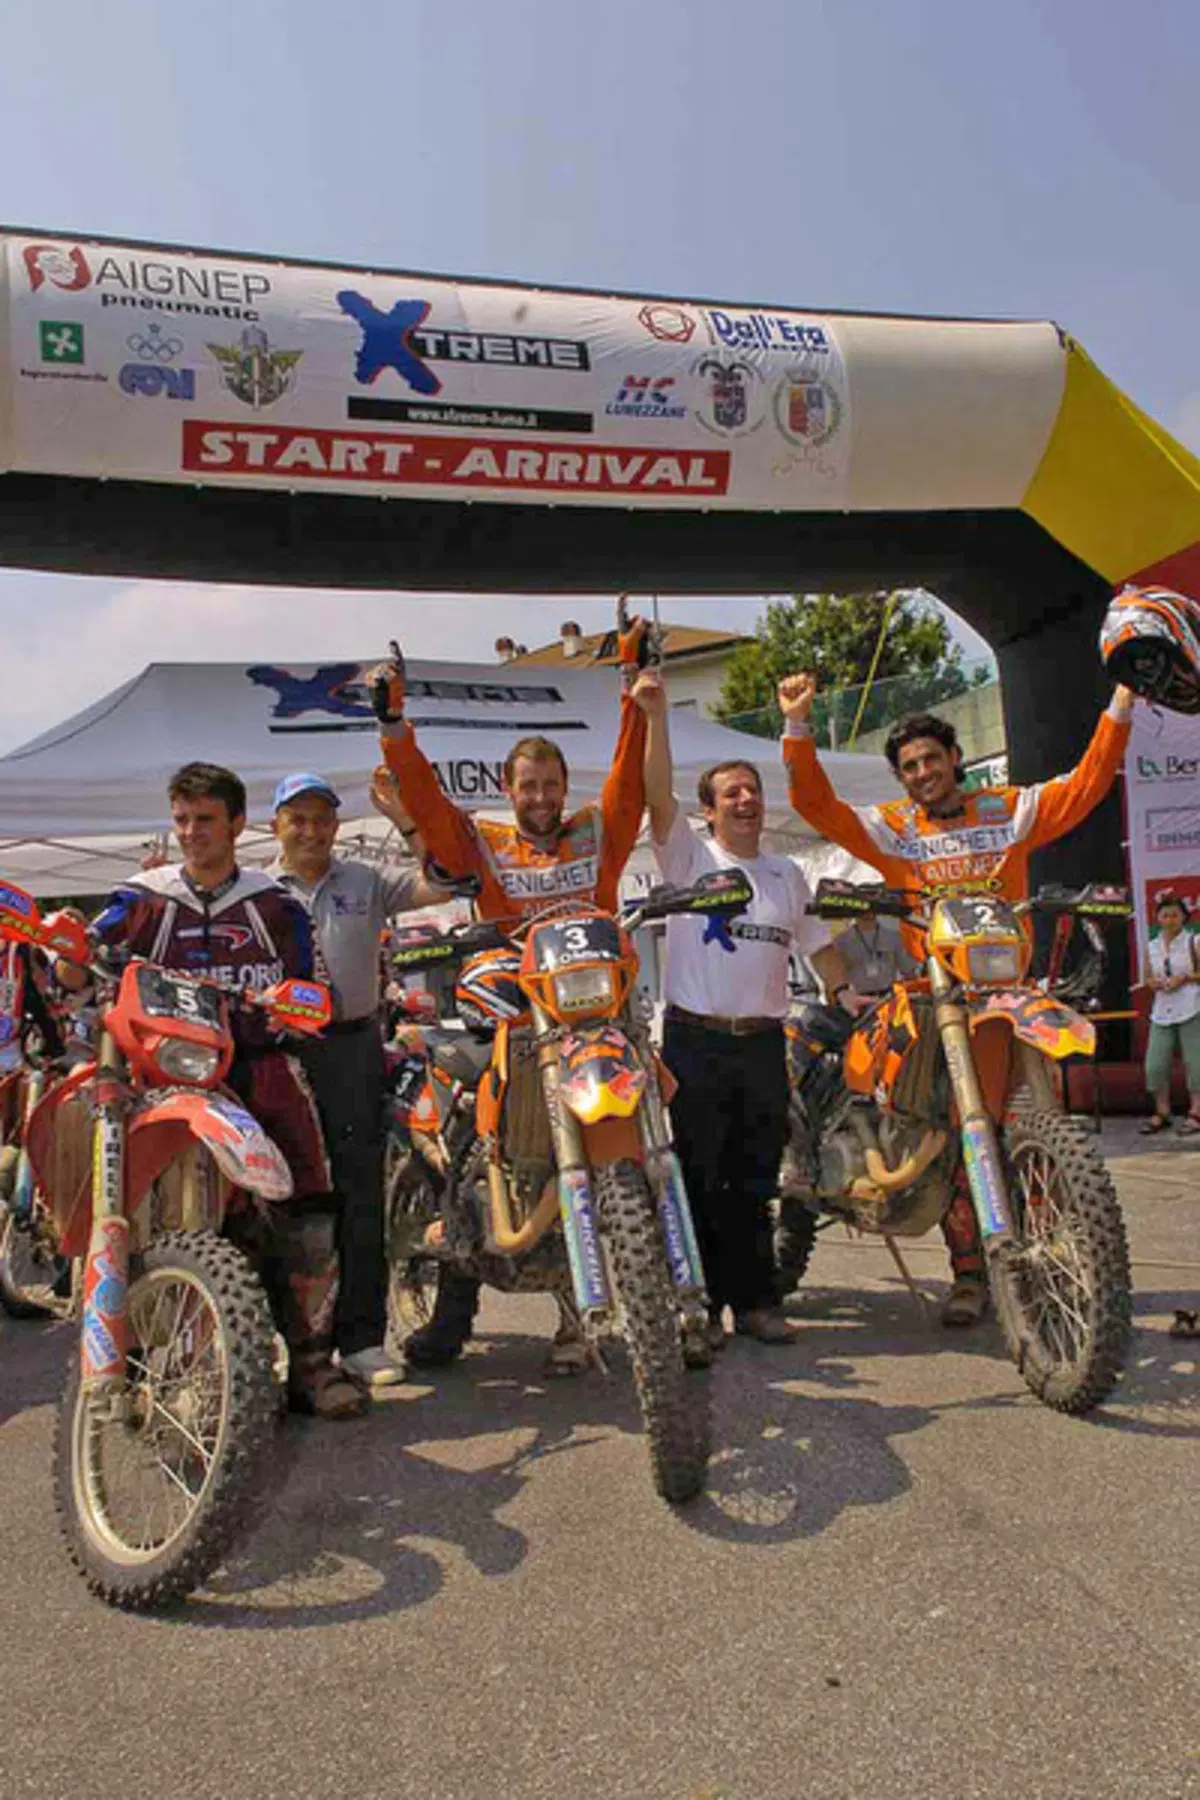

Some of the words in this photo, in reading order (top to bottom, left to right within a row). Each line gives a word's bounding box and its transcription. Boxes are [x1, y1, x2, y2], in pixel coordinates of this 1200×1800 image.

[96, 257, 271, 304] AIGNEP
[101, 293, 260, 322] pneumatic
[709, 309, 828, 347] Dall'Era
[201, 430, 413, 475] START
[452, 446, 717, 487] ARRIVAL
[971, 905, 999, 926] 2
[562, 924, 589, 949] 3
[176, 988, 200, 1014] 5
